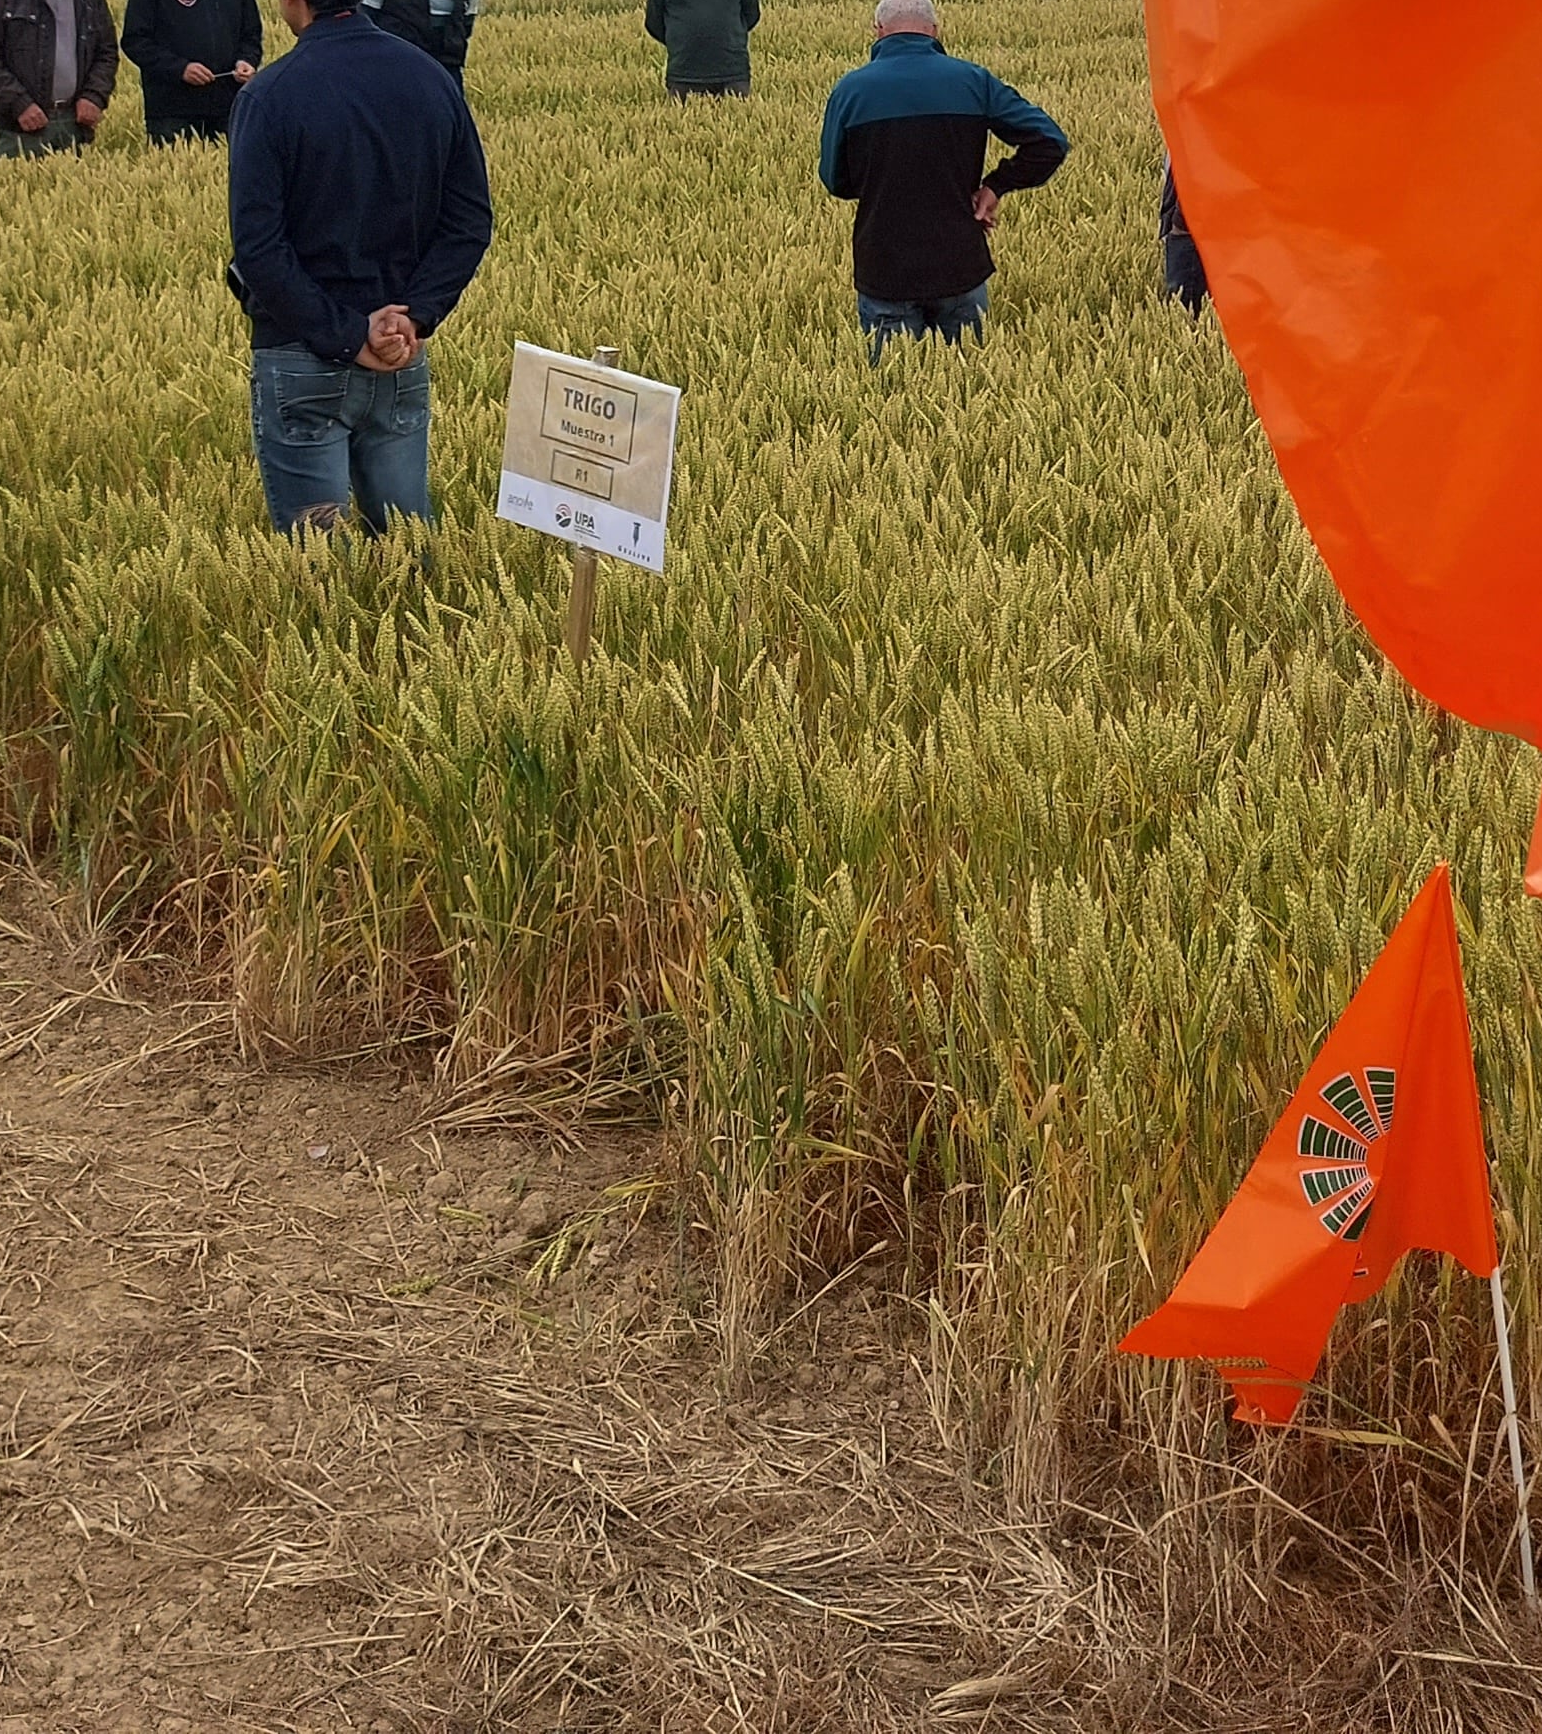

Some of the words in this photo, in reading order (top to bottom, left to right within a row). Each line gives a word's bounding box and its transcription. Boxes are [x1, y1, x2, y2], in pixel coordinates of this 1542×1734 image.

[563, 387, 616, 420] TRIGO
[561, 419, 606, 444] Muestra
[609, 434, 615, 447] 1
[575, 468, 588, 483] R1
[574, 510, 596, 530] UPA
